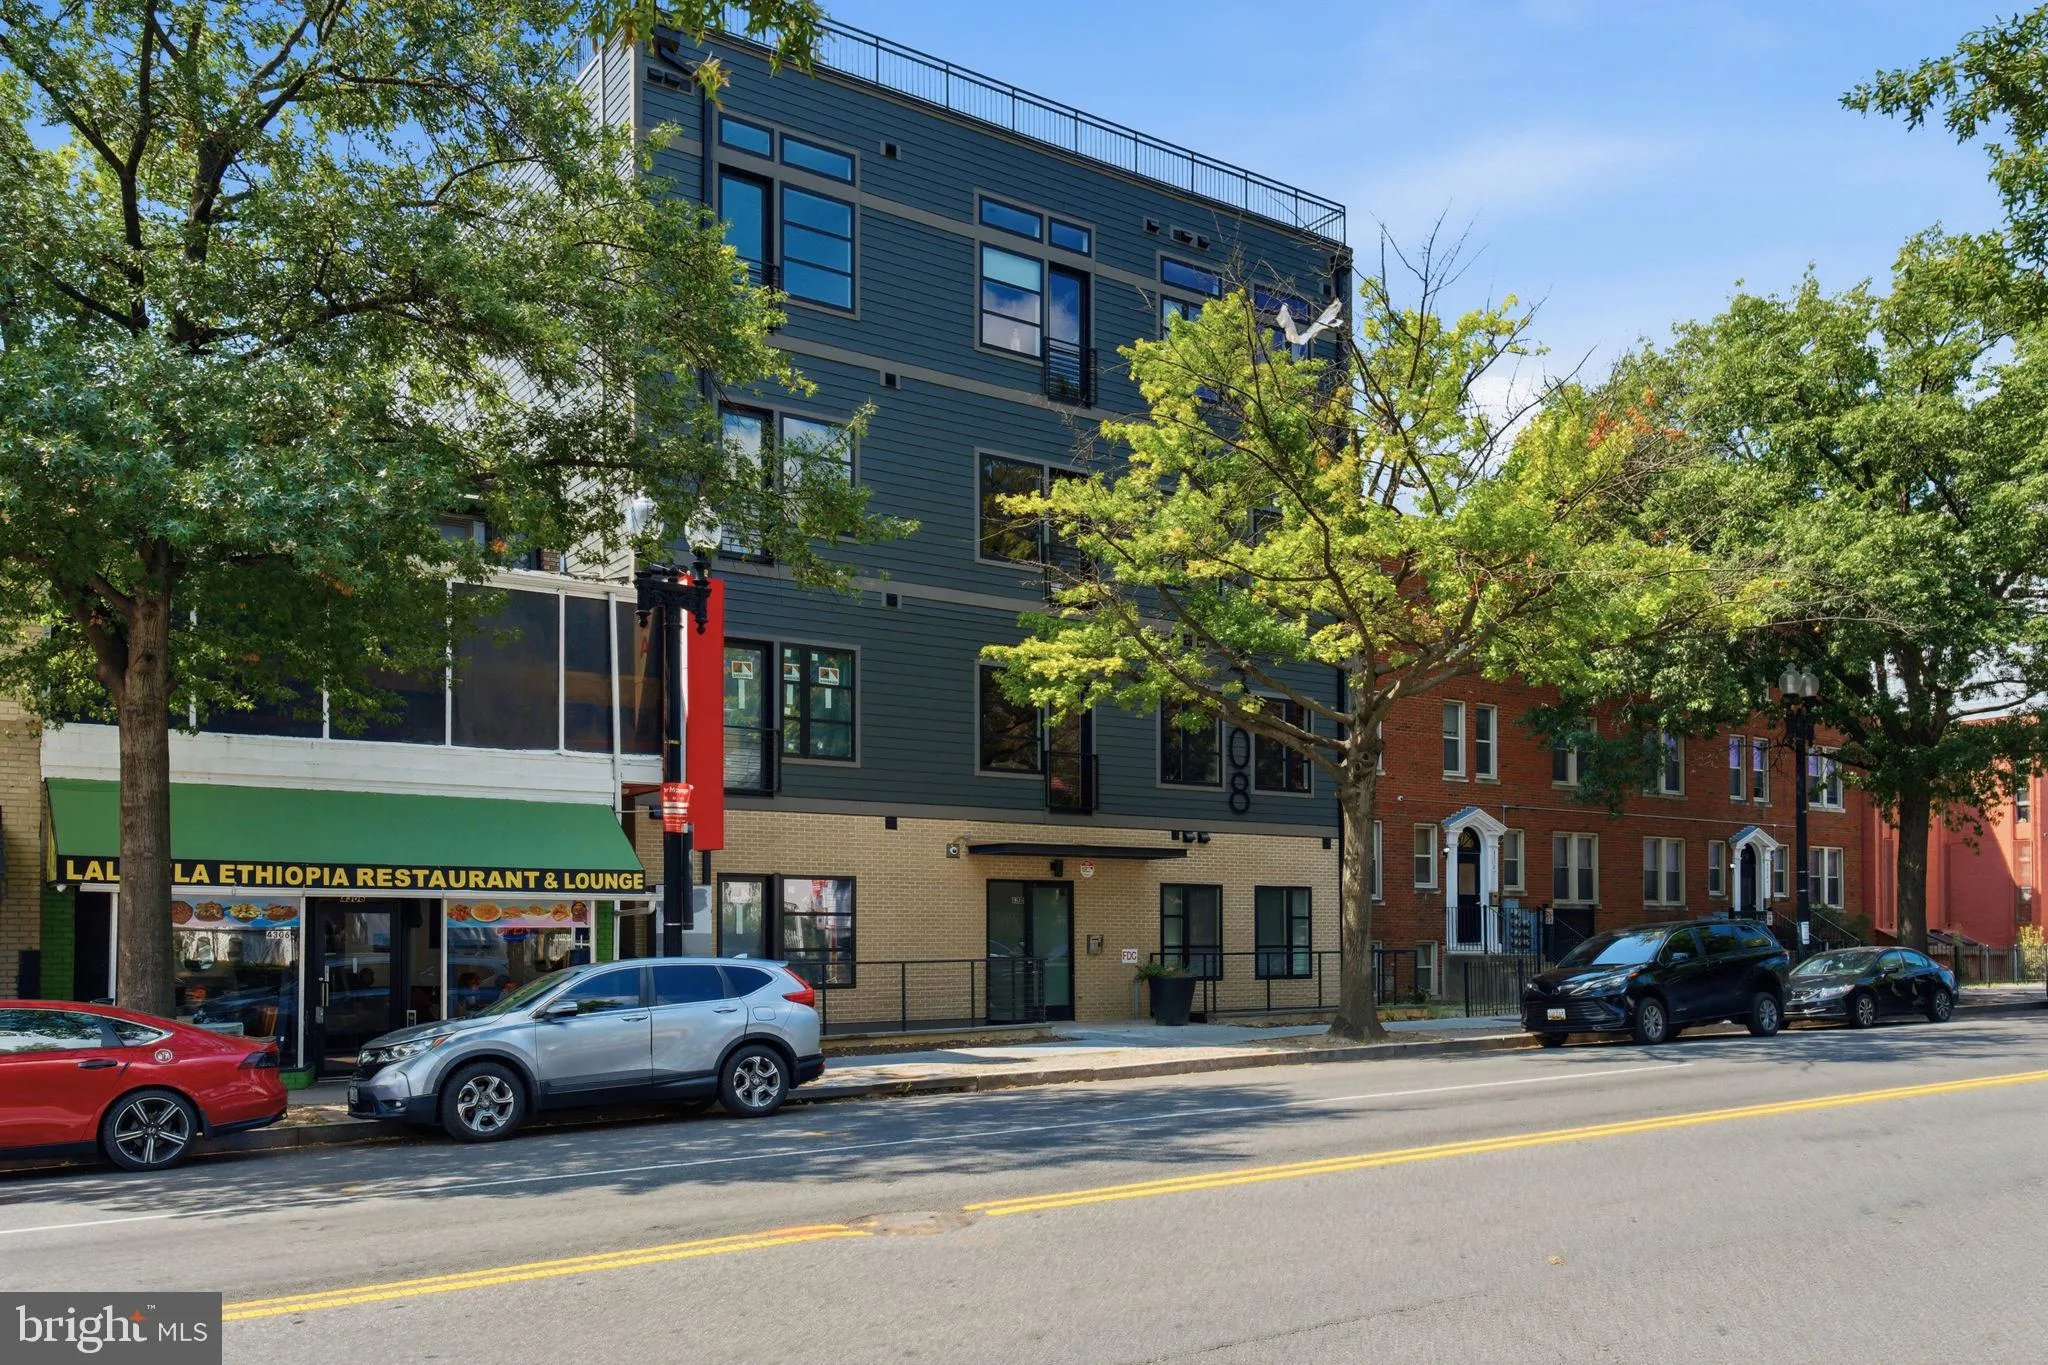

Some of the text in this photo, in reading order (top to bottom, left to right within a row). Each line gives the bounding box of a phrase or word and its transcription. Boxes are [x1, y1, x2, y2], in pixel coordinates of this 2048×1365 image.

[66, 860, 644, 890] LALLA ETHIOPIA RESTAURANT & LOUNGE
[266, 931, 290, 939] 4306
[1123, 951, 1137, 961] FDC
